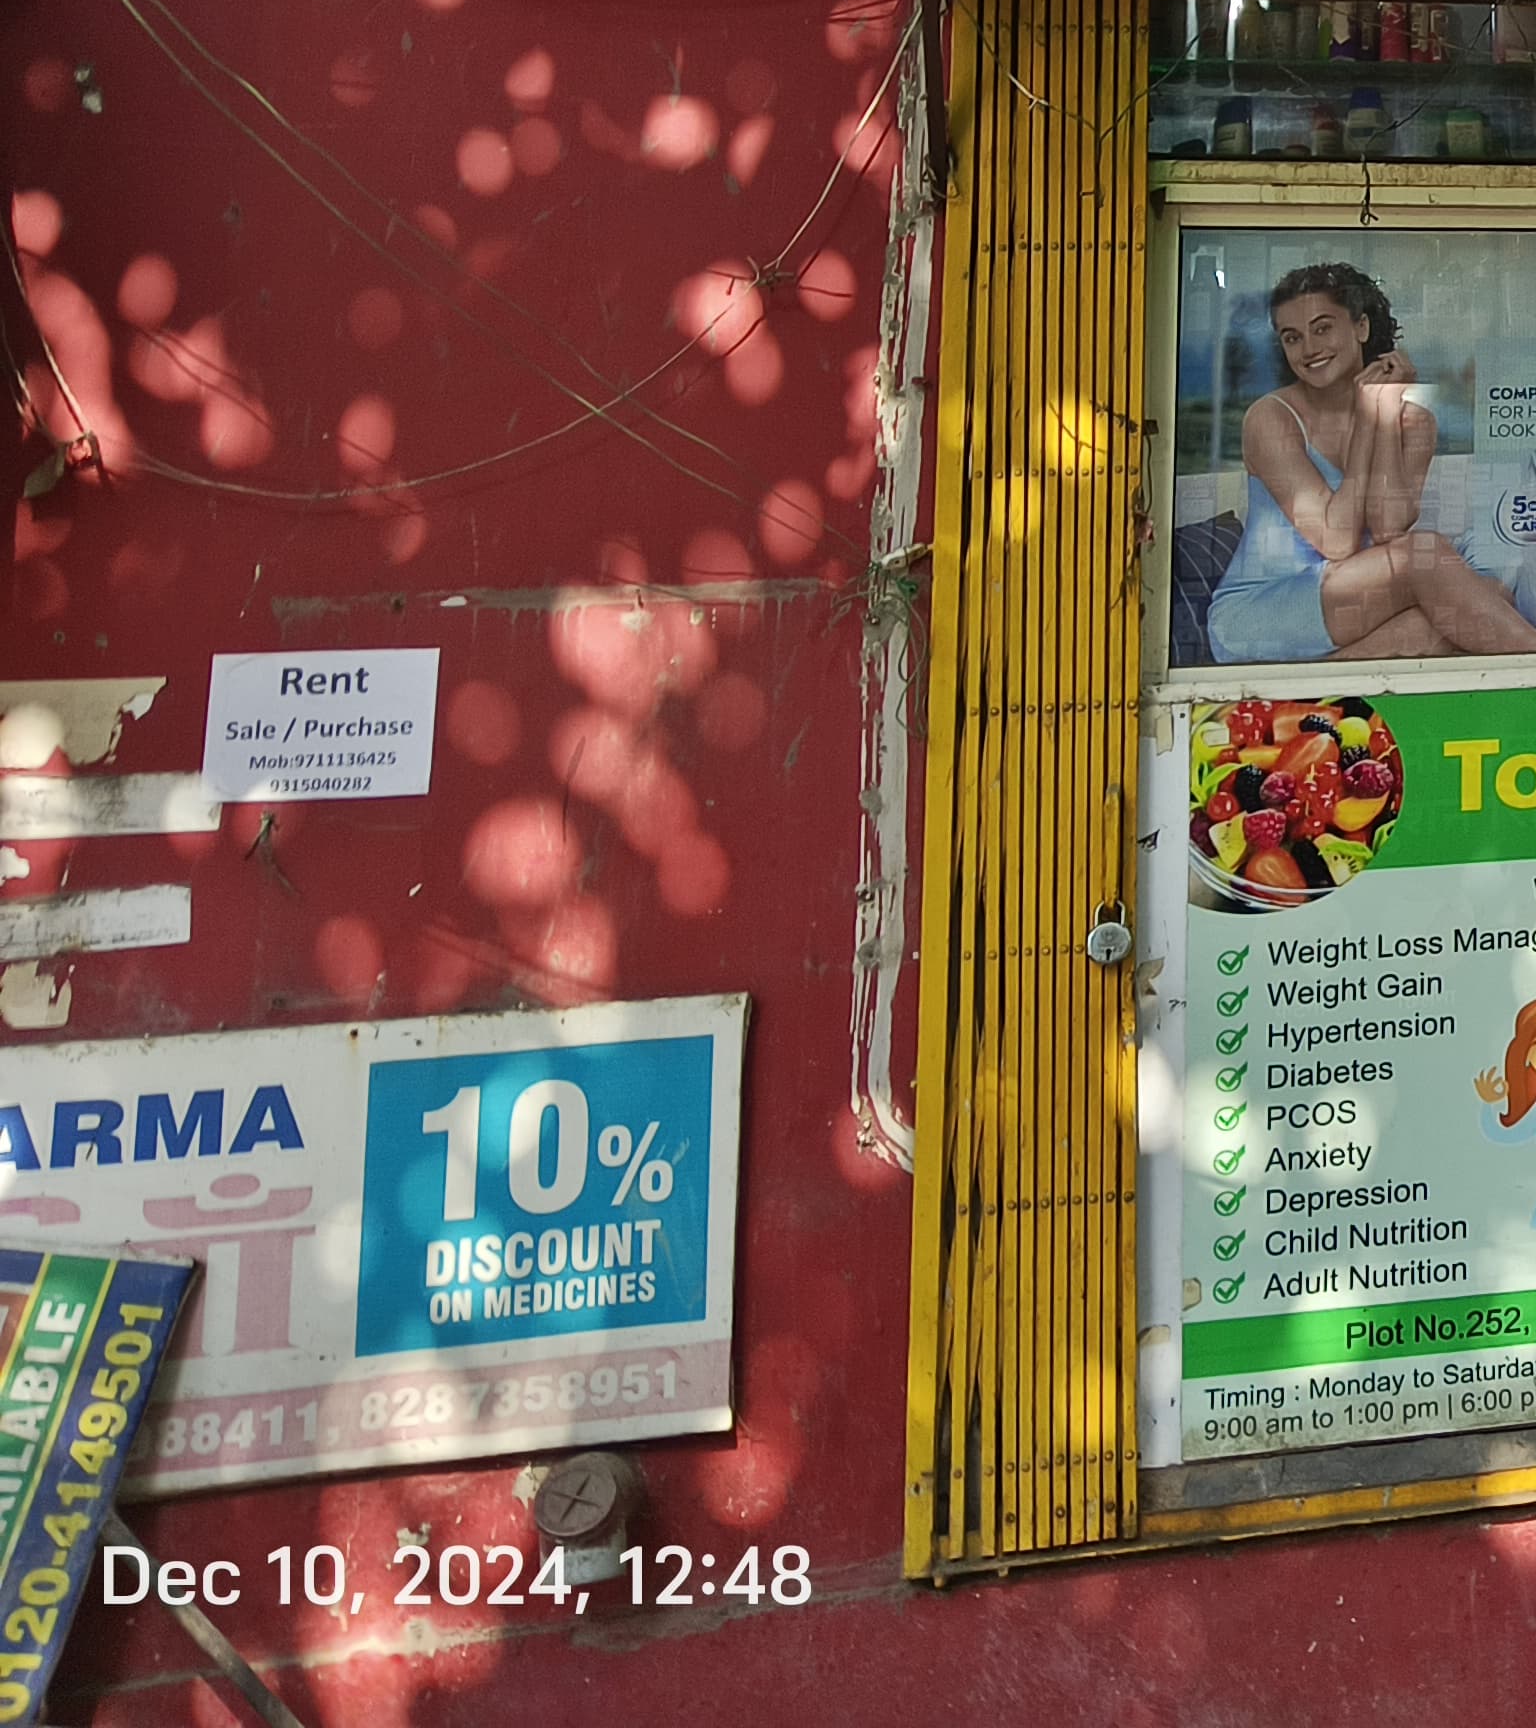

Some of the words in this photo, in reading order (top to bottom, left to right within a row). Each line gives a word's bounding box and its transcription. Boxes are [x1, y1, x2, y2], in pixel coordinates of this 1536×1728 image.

[1489, 405, 1523, 420] FOR
[280, 666, 370, 697] Rent
[225, 720, 277, 742] Sale
[303, 716, 414, 741] Purchase
[1266, 938, 1369, 973] Weight
[1377, 933, 1444, 961] Loss
[1266, 1011, 1456, 1054] Hypertension
[1266, 1057, 1394, 1091] Diabetes
[1265, 1099, 1358, 1133] PCOS
[421, 1077, 675, 1223] 10%
[1264, 1141, 1373, 1178] Anxiety
[1265, 1177, 1430, 1223] Depression
[425, 1218, 663, 1287] DISCOUNT
[1264, 1224, 1339, 1259] Child
[1348, 1214, 1468, 1254] Nutrition
[429, 1291, 473, 1326] ON
[484, 1271, 657, 1321] MEDICINES
[1344, 1319, 1405, 1352] Plot
[1413, 1306, 1530, 1347] No.252,
[359, 1360, 680, 1434] 8287358951
